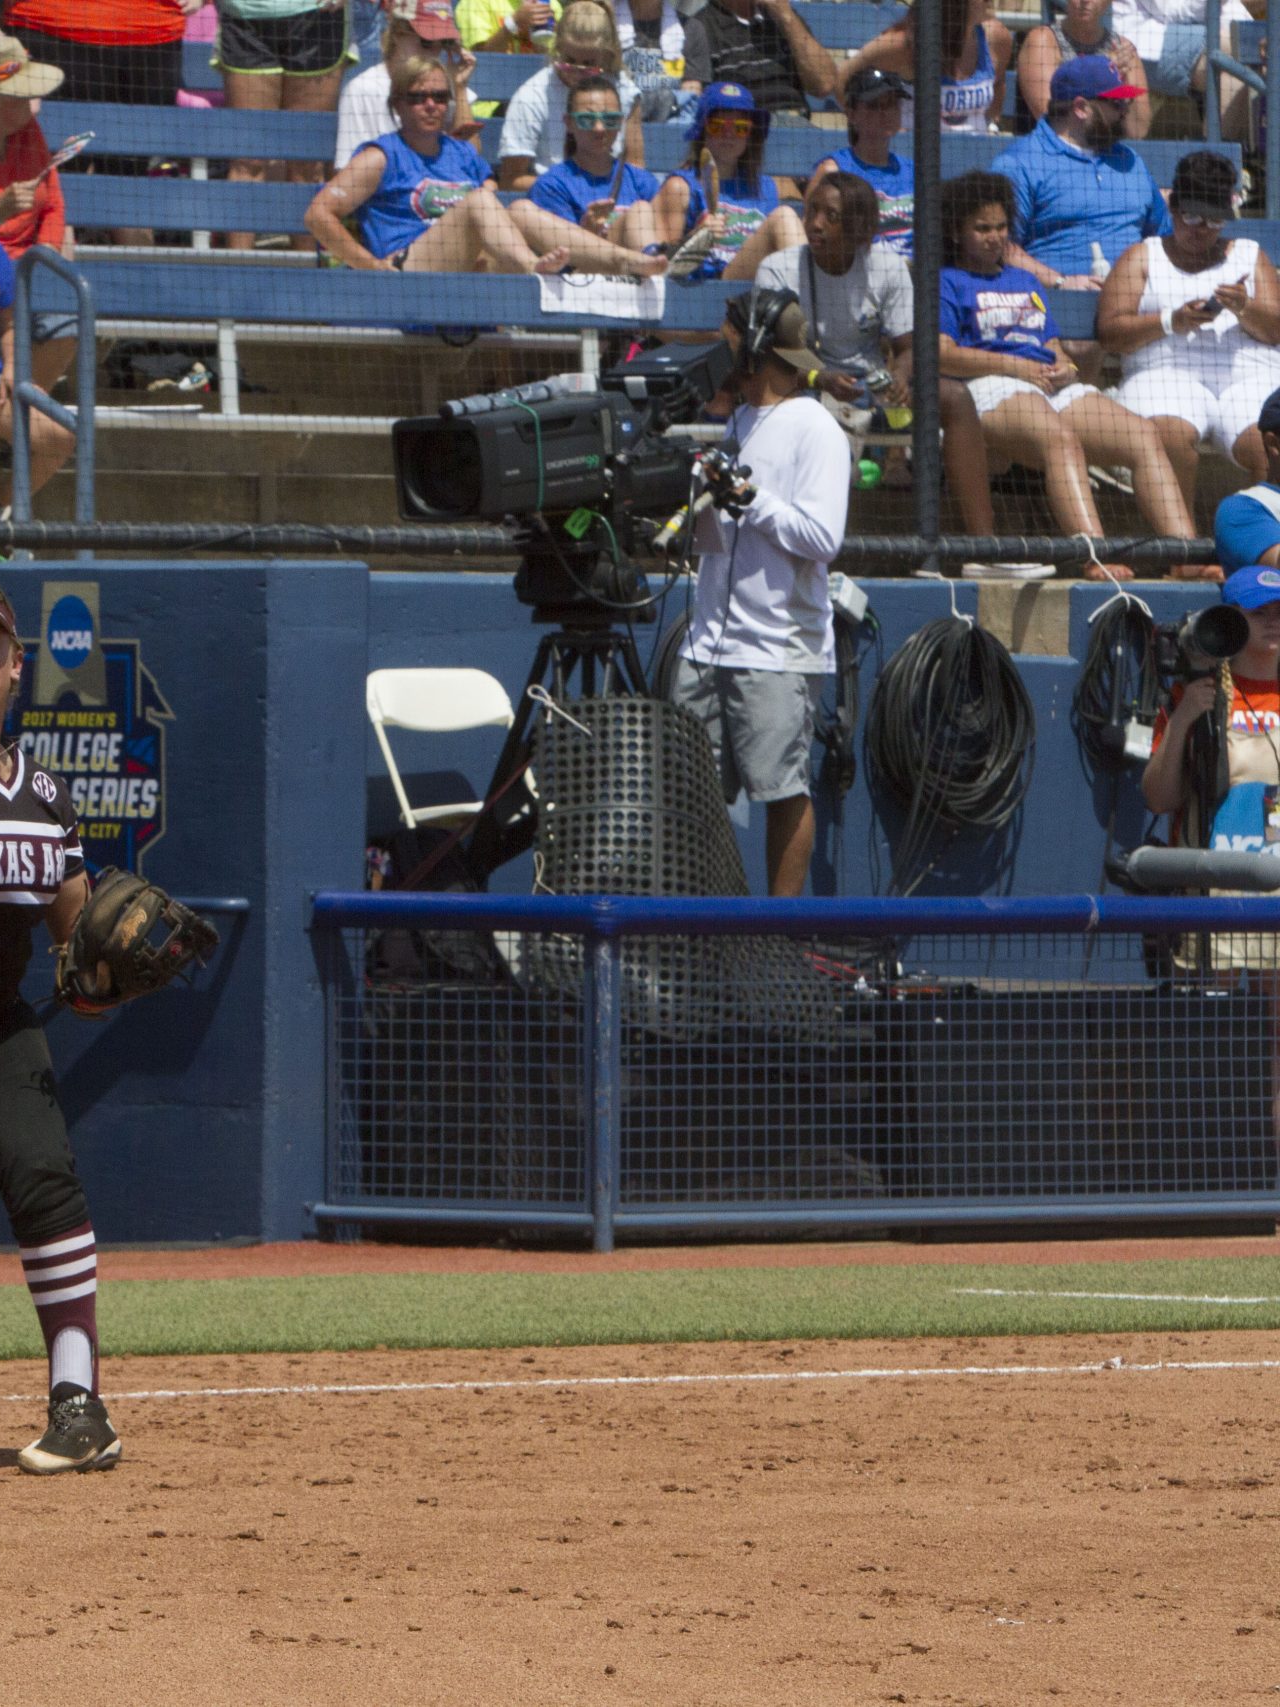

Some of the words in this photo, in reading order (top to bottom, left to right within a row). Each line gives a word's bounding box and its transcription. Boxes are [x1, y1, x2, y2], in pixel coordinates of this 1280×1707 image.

[51, 630, 92, 650] NCAA
[22, 712, 54, 727] 2017
[56, 712, 117, 728] WOMEN'S
[34, 773, 55, 800] SEC
[71, 777, 159, 818] SERIES
[89, 824, 122, 838] CITY
[42, 842, 66, 886] A&
